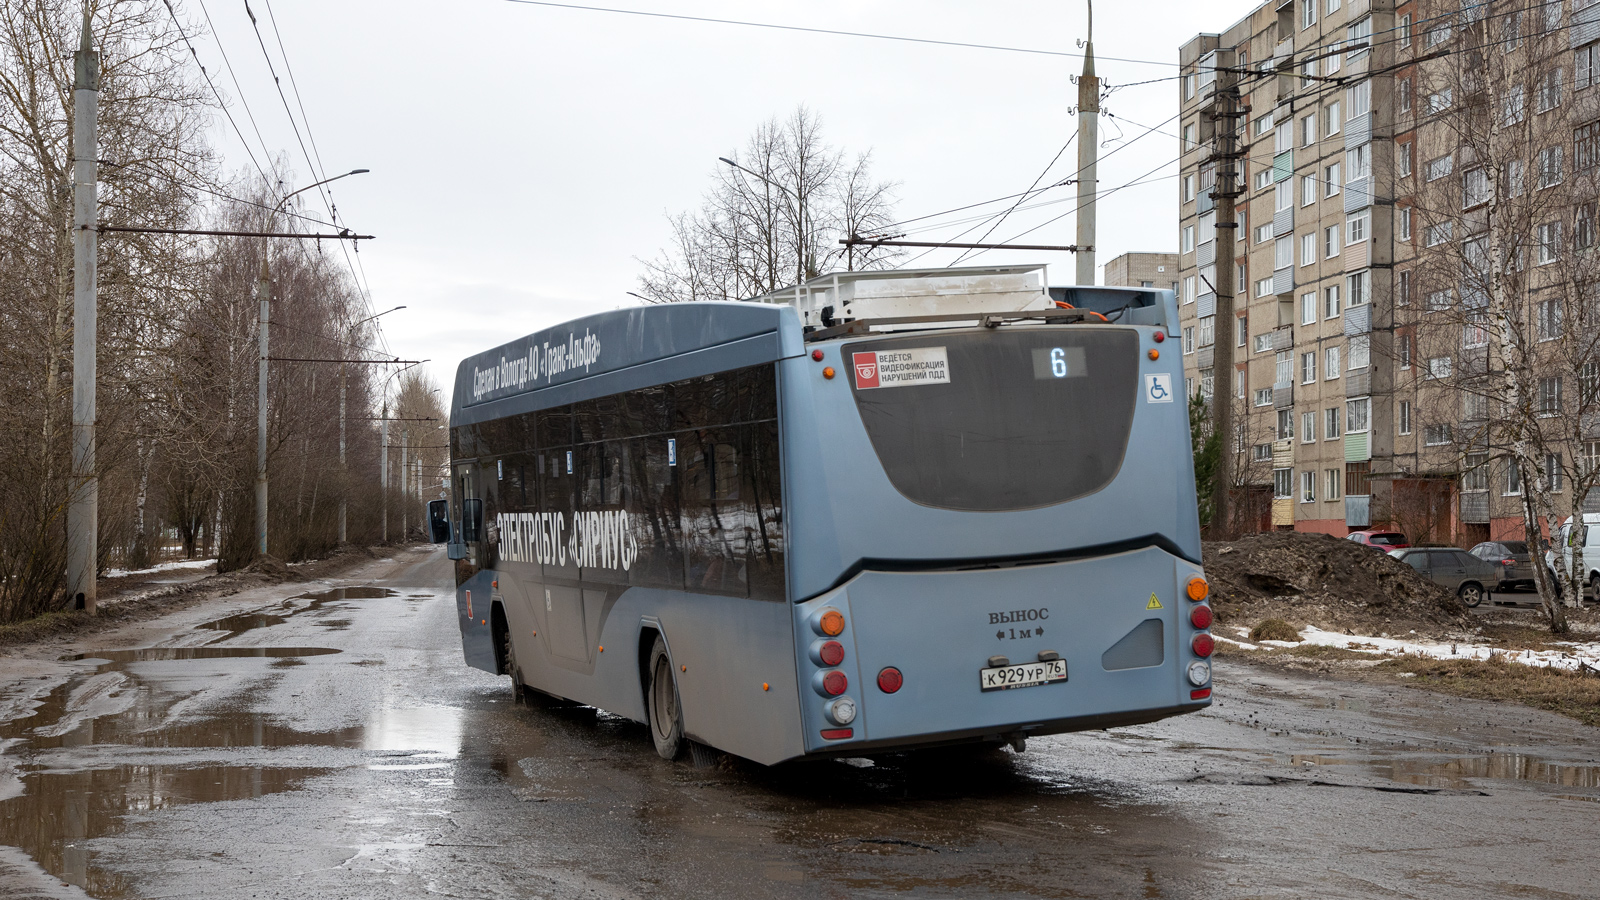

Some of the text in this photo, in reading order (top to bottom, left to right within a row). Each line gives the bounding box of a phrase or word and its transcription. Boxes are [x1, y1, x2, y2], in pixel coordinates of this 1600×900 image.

[473, 327, 601, 401] Сделан в Вологде АО «Транс-Альфа»
[879, 353, 912, 363] ВЕДЁТСЯ
[1050, 347, 1067, 378] 6
[880, 360, 945, 373] ВИДЕОФИКСАЦИЯ
[881, 370, 945, 382] НАРУШЕНИЙ ПДД
[496, 509, 638, 571] ЭЛЕКТРОБУС «СИРИУС»
[988, 607, 1049, 625] ВЫНОС
[1009, 628, 1016, 640] 1
[1047, 661, 1061, 674] 76
